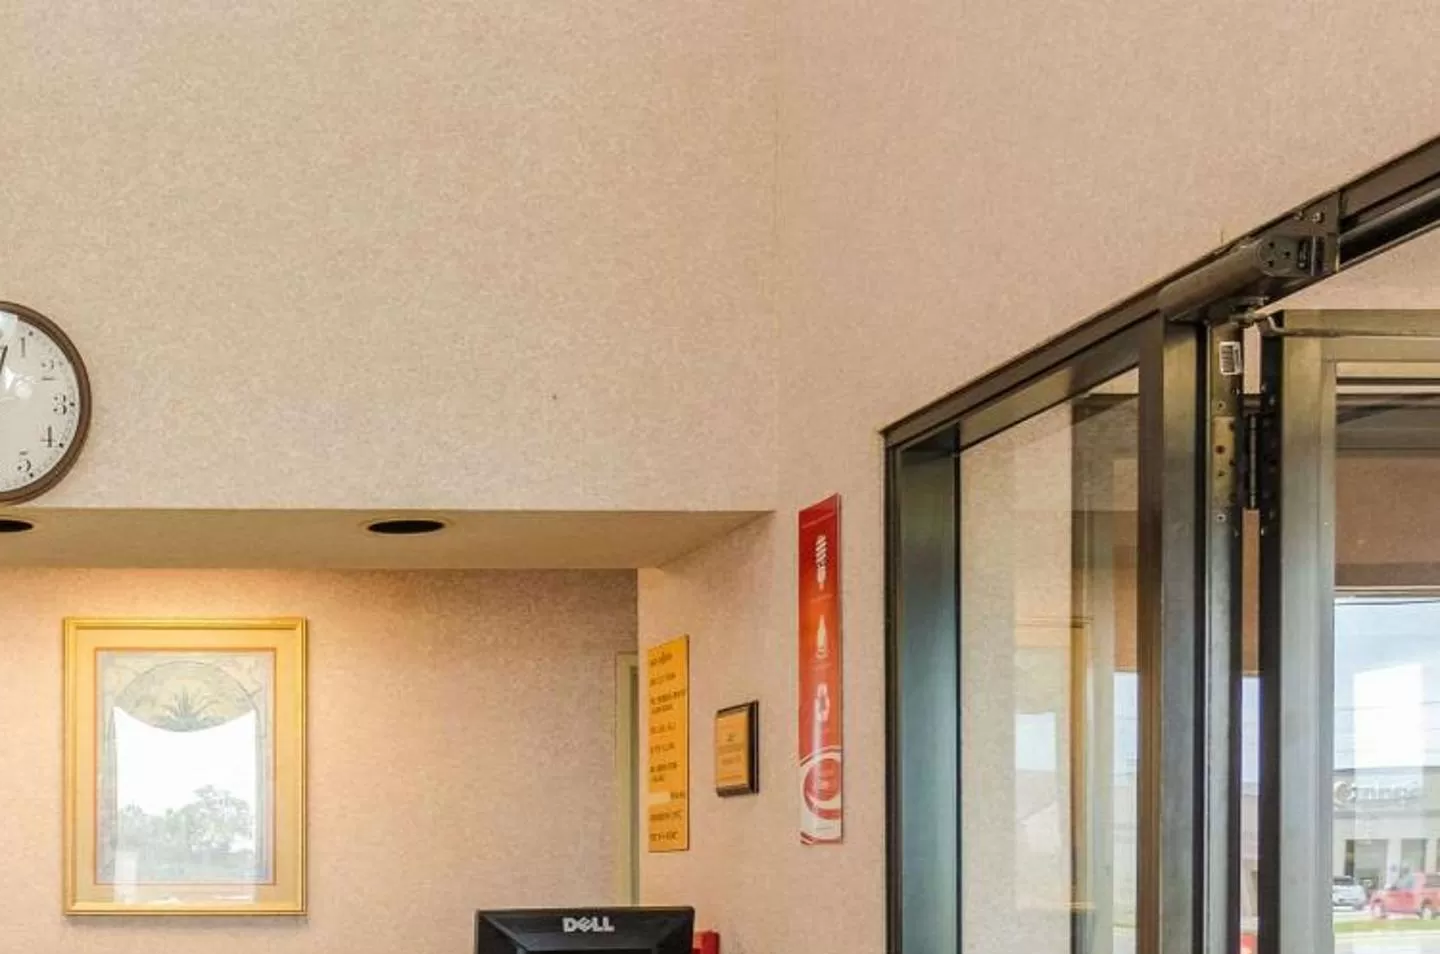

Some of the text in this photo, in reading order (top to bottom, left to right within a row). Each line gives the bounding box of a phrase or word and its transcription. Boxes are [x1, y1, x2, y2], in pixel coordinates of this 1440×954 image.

[19, 336, 26, 358] 1
[53, 393, 68, 415] 3
[40, 426, 58, 448] 4
[17, 450, 32, 473] 5
[562, 916, 615, 932] DELL
